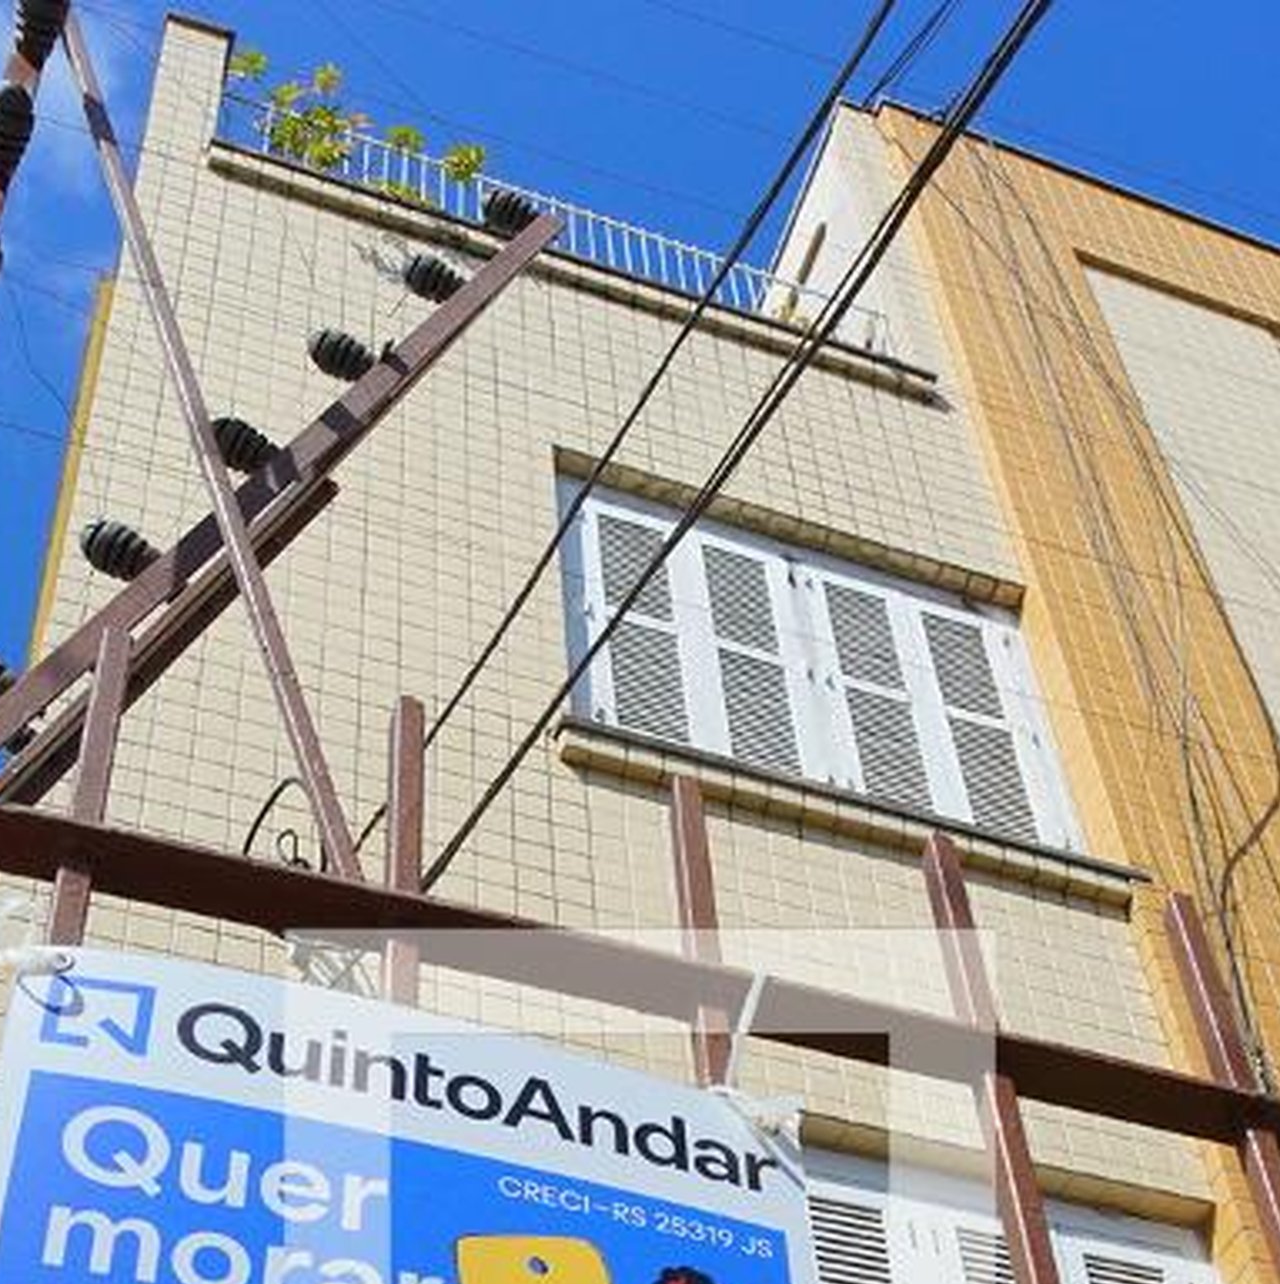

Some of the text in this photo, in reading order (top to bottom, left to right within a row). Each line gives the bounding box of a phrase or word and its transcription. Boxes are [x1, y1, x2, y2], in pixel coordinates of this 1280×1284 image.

[177, 1003, 779, 1191] QuintoAndar
[62, 1105, 388, 1231] Quer
[653, 1211, 733, 1247] 25319
